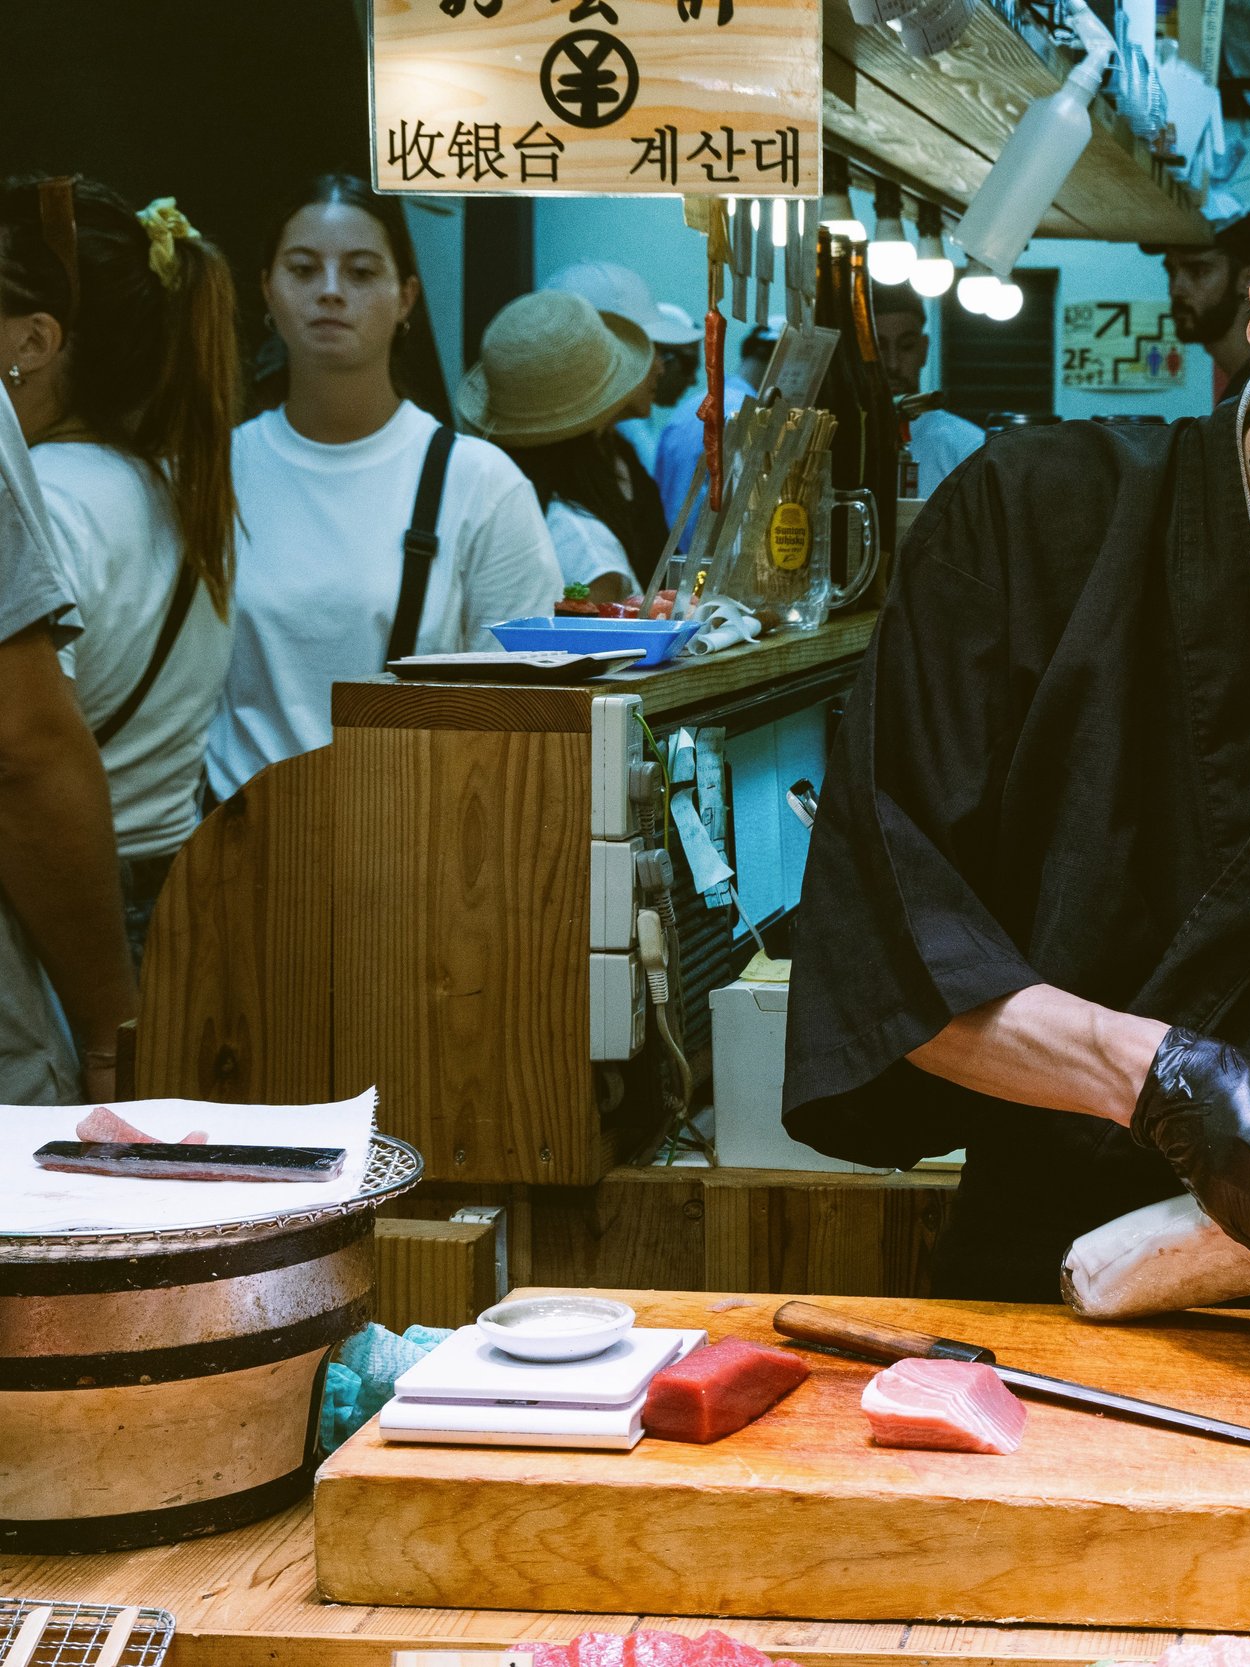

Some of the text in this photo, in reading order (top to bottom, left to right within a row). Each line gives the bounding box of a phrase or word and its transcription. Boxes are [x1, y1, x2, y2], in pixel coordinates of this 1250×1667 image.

[387, 119, 565, 183] 收银台
[629, 124, 800, 188] 계산대
[775, 535, 805, 546] Whisky
